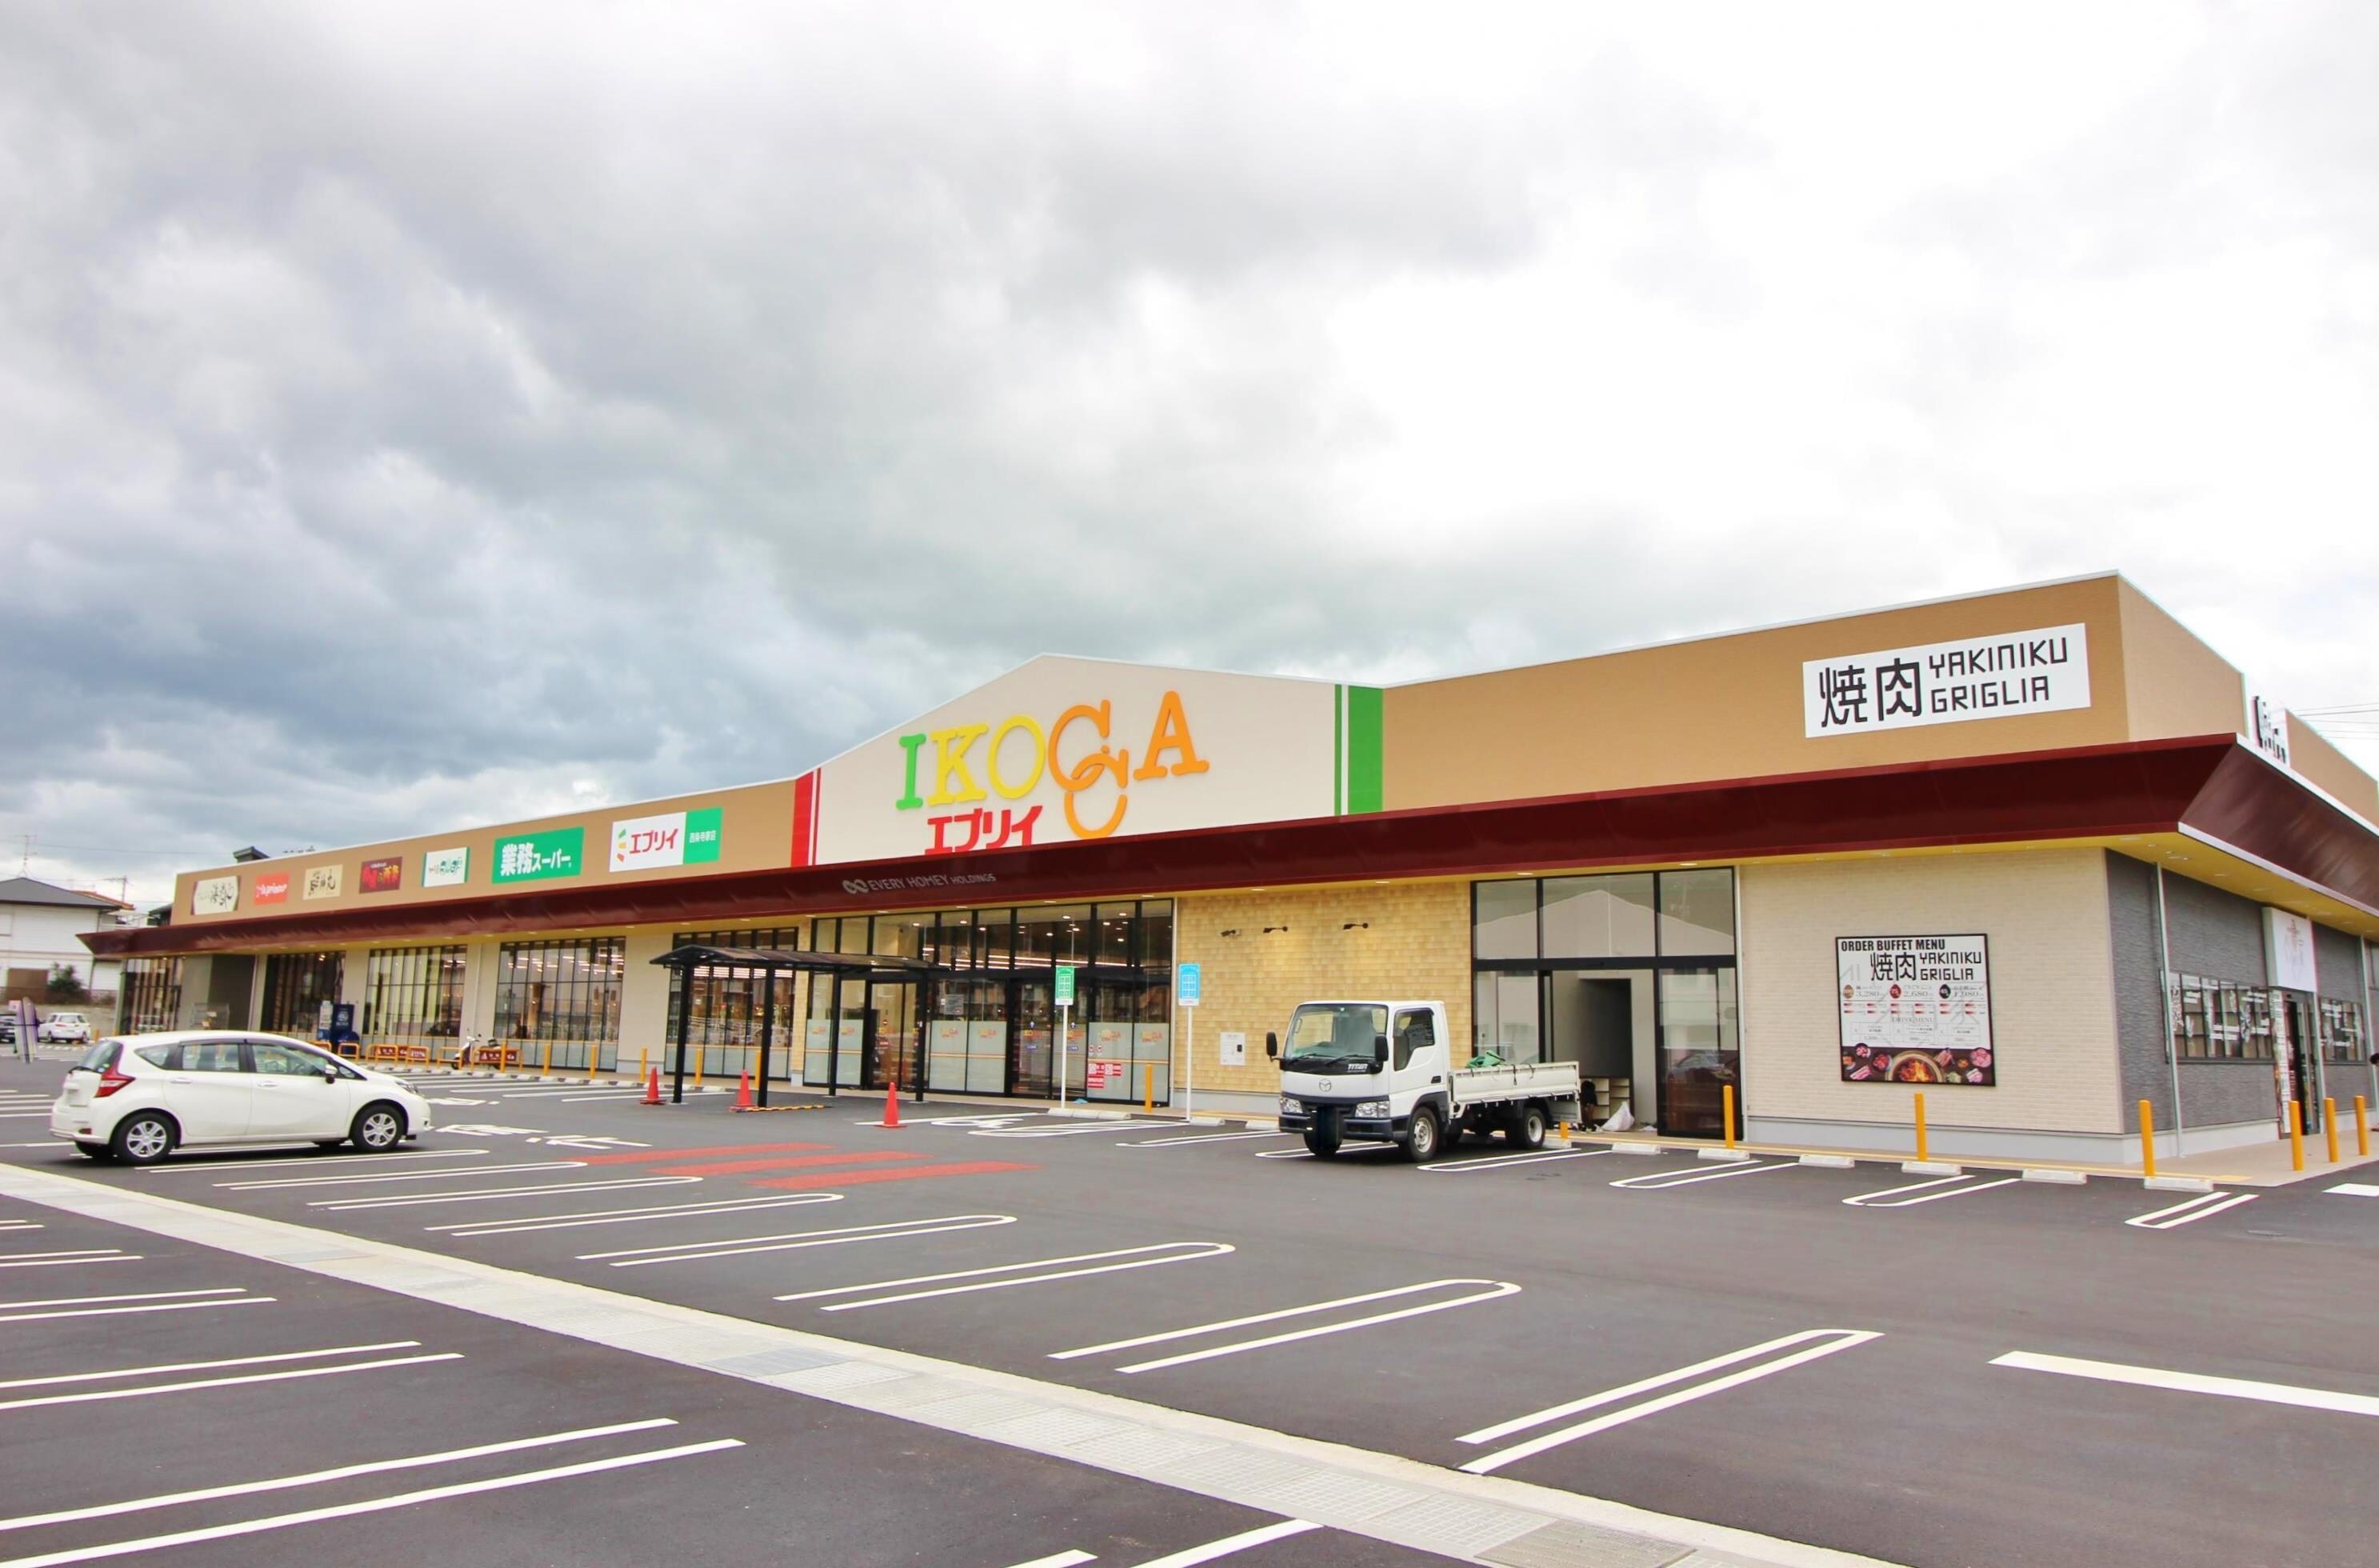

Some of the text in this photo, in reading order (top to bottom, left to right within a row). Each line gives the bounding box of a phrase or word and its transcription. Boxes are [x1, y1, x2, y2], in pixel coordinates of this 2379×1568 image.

[1929, 637, 2068, 679] YAKINIKU
[1819, 658, 1922, 728] 焼肉
[1930, 675, 2049, 714] GRIGLIA
[500, 842, 572, 877] 業務スーパー
[868, 873, 997, 891] EVERY HOMEY HOLDINGS
[1841, 939, 1945, 952] ORDER BUFFET MENU
[1920, 951, 1982, 965] YAKINIKU
[1870, 952, 1917, 982] 焼肉
[1921, 968, 1974, 981] GRIGLIA
